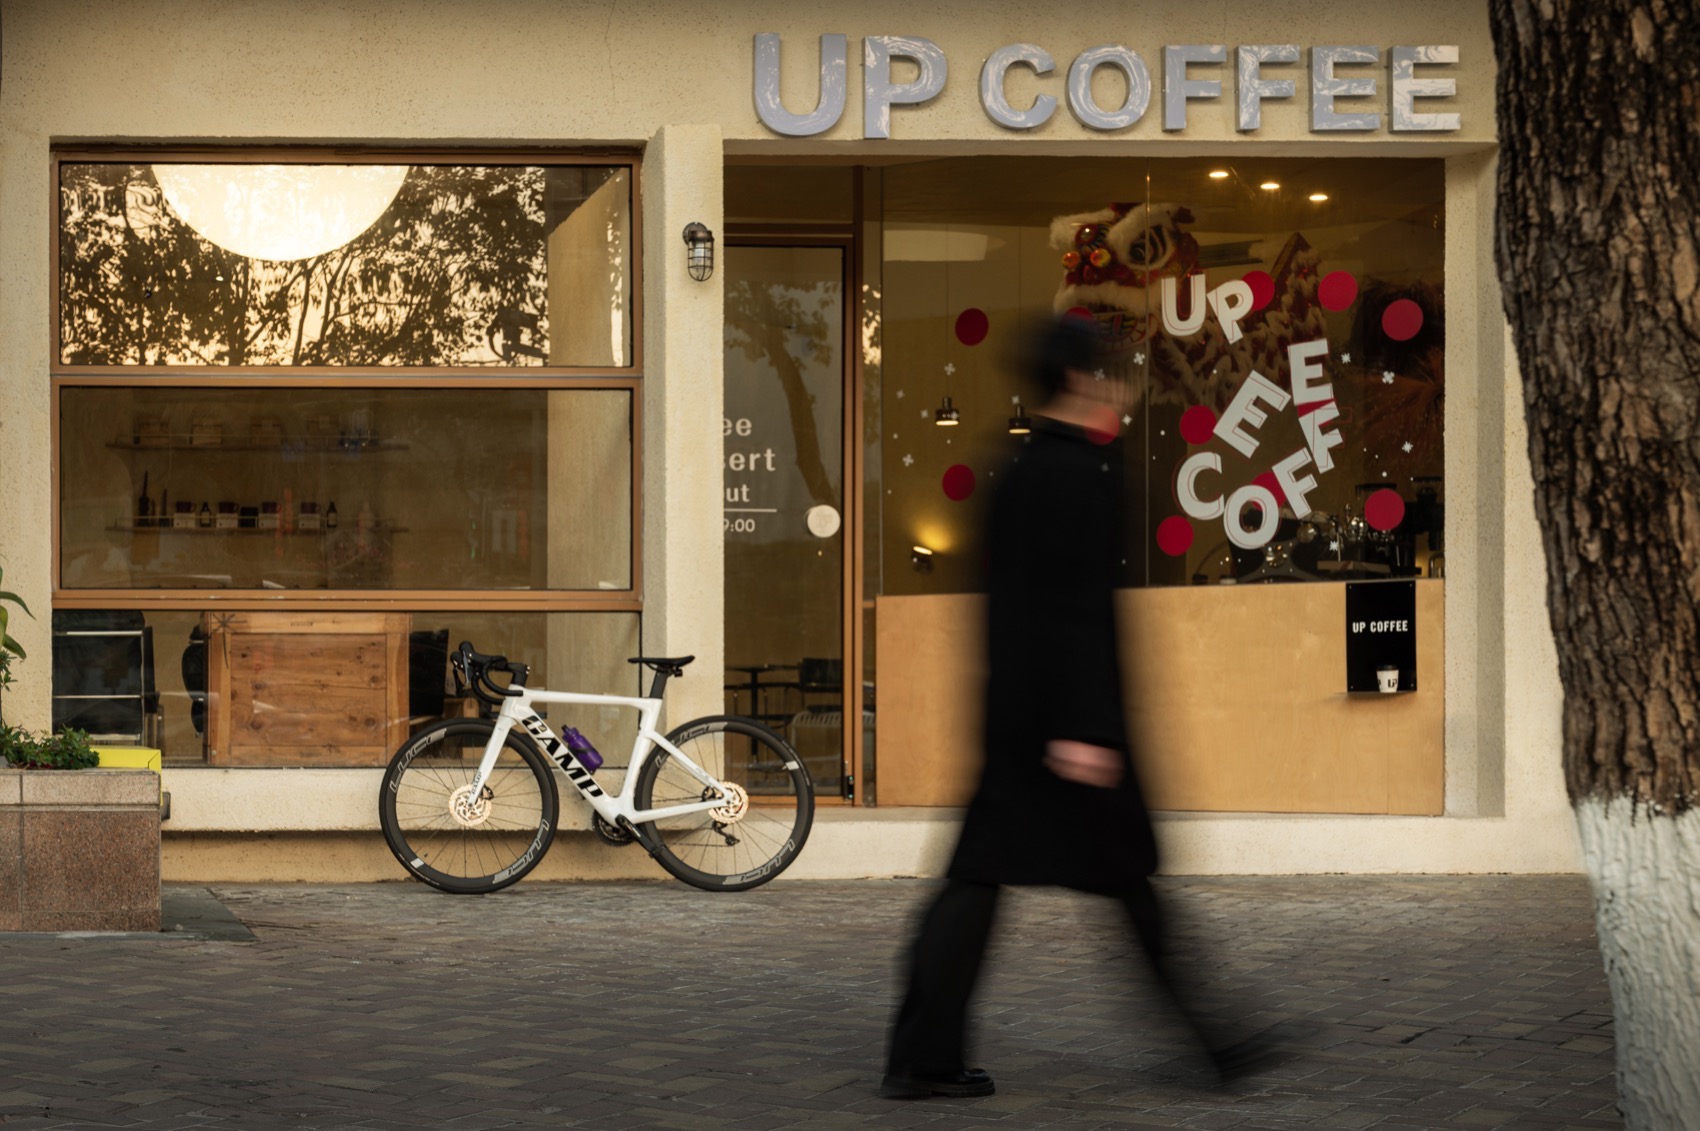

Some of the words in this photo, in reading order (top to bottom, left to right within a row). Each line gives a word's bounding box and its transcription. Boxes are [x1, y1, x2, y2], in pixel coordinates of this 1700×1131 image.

[753, 32, 949, 139] UP
[978, 43, 1461, 132] COFFEE
[1161, 274, 1254, 345] UP
[723, 448, 776, 472] ert
[1352, 621, 1366, 634] UP
[1370, 620, 1408, 633] COFFEE
[522, 715, 604, 797] CAMP
